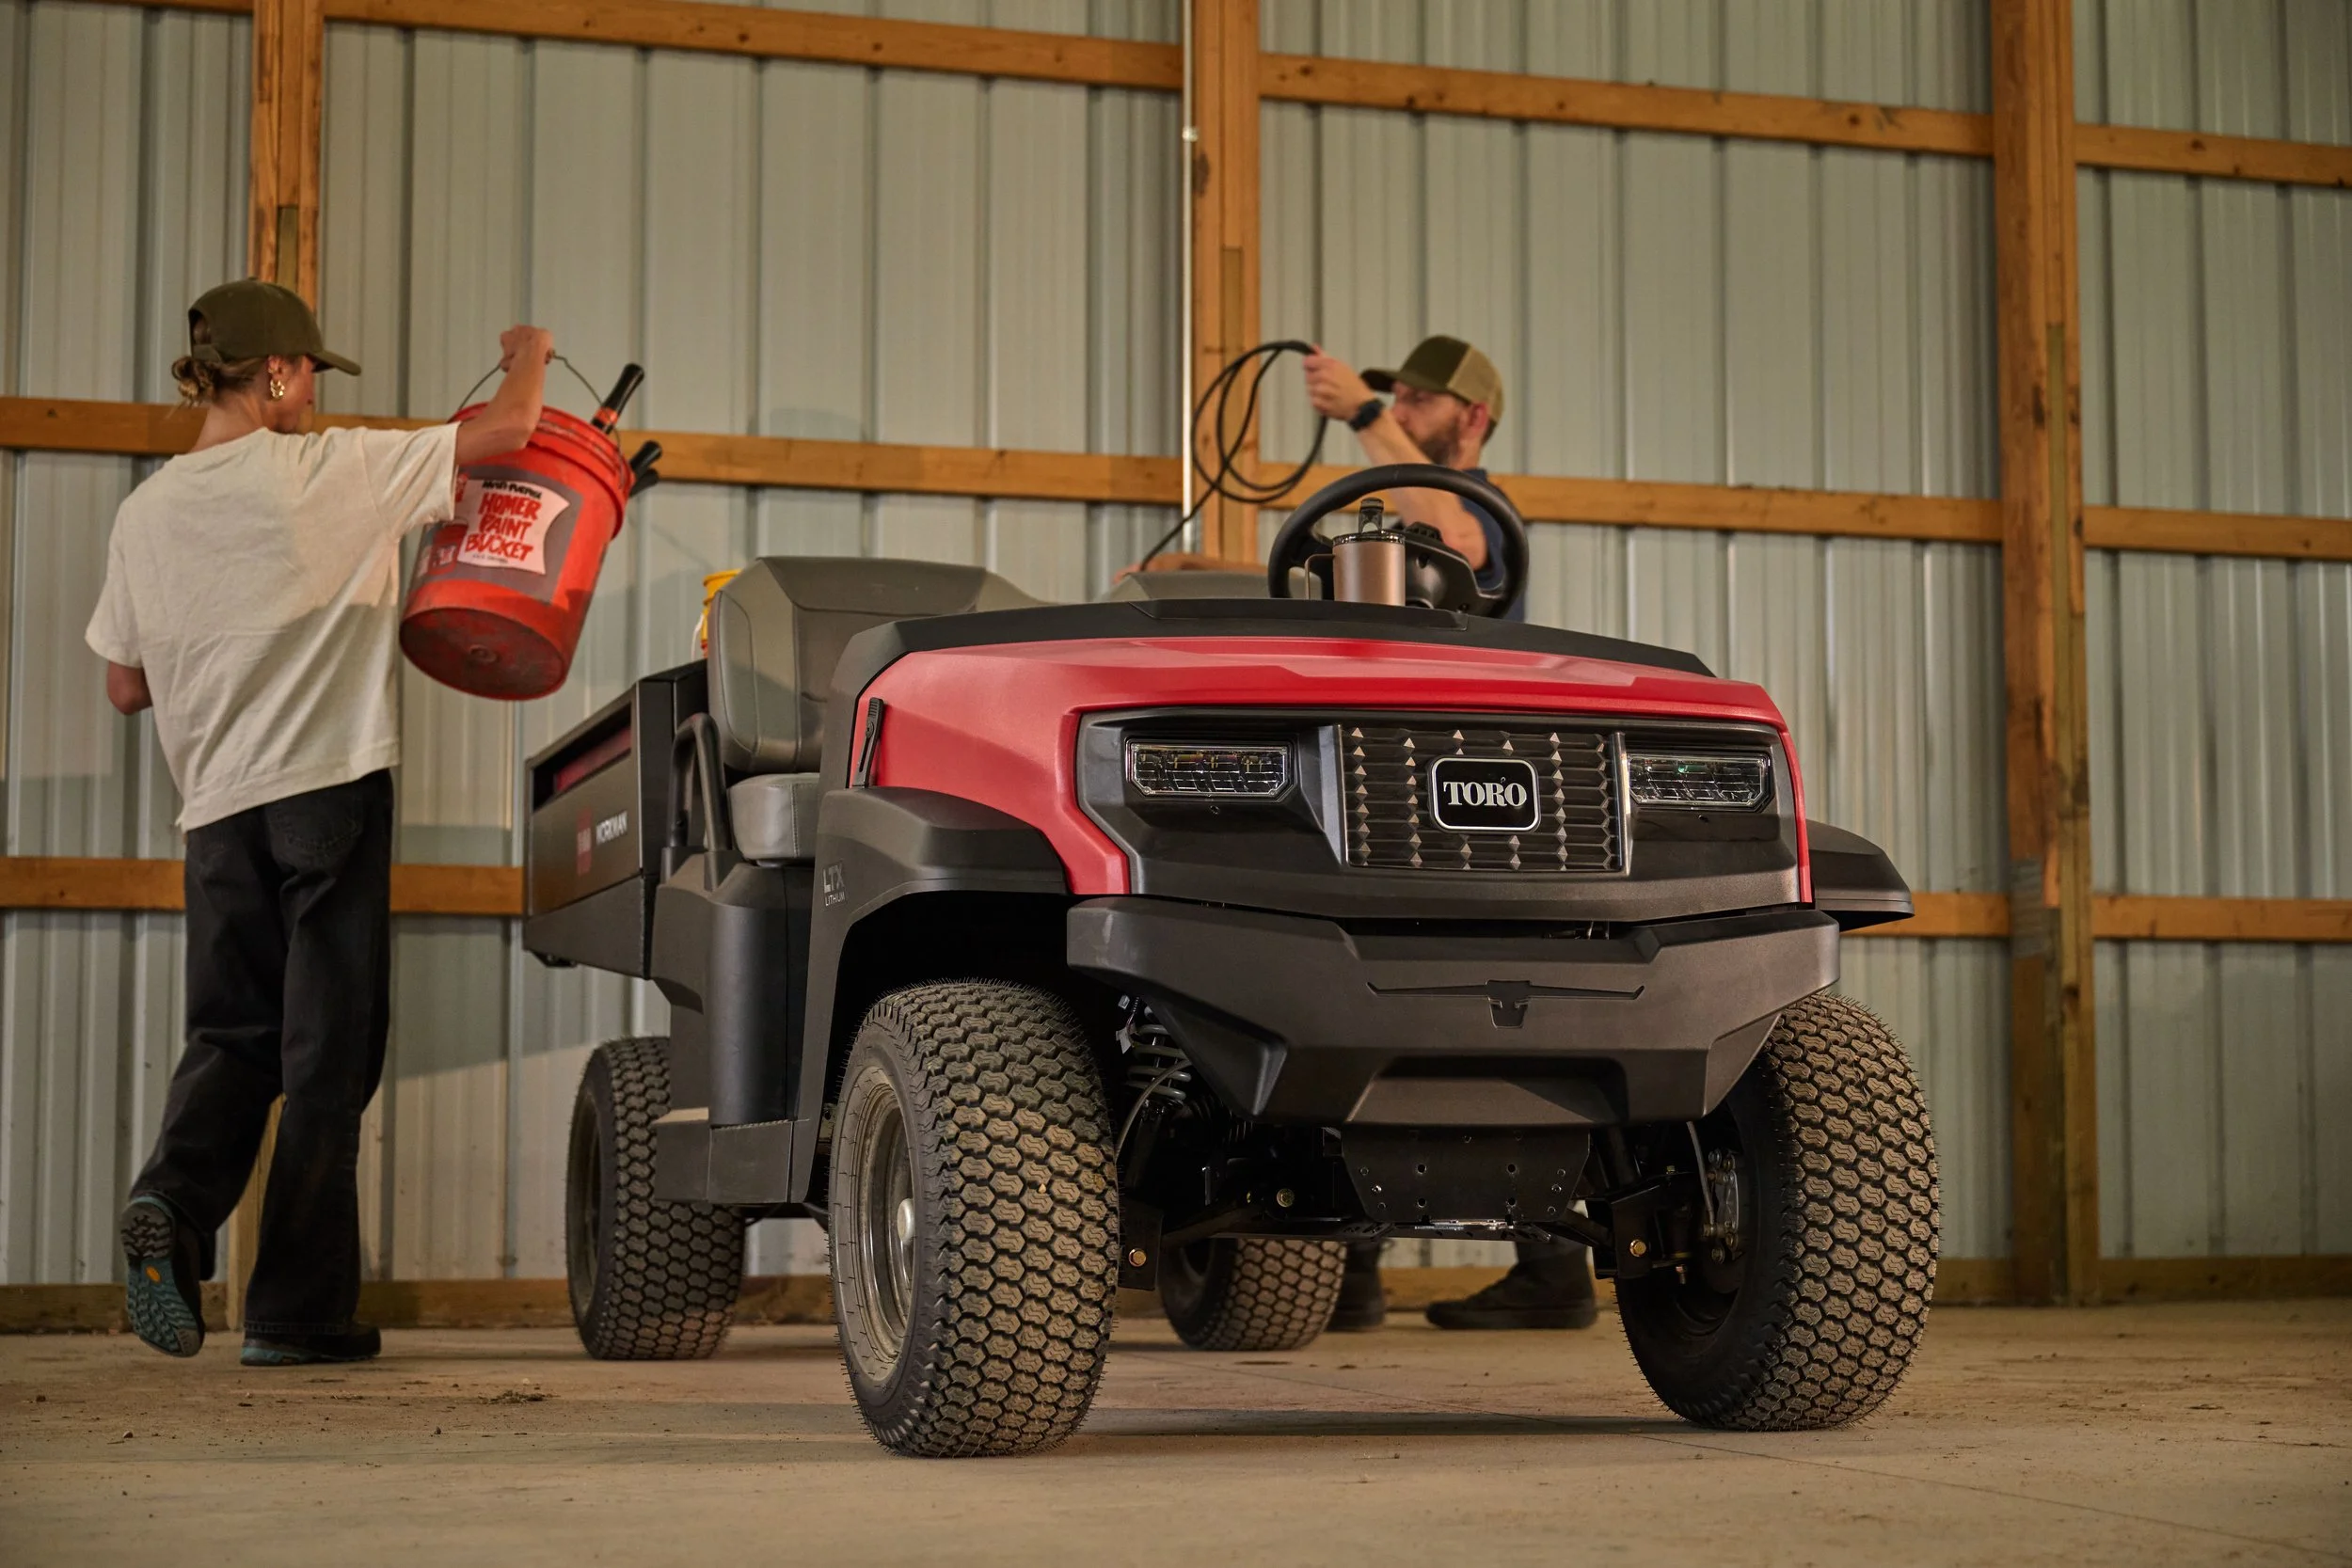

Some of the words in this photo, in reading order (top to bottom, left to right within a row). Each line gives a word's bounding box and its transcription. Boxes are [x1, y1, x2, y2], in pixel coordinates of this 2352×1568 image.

[478, 492, 541, 520] HOMER
[479, 514, 532, 540] PAINT
[465, 533, 533, 562] BUCKET
[1442, 782, 1527, 807] TORO
[823, 863, 845, 894] LTX
